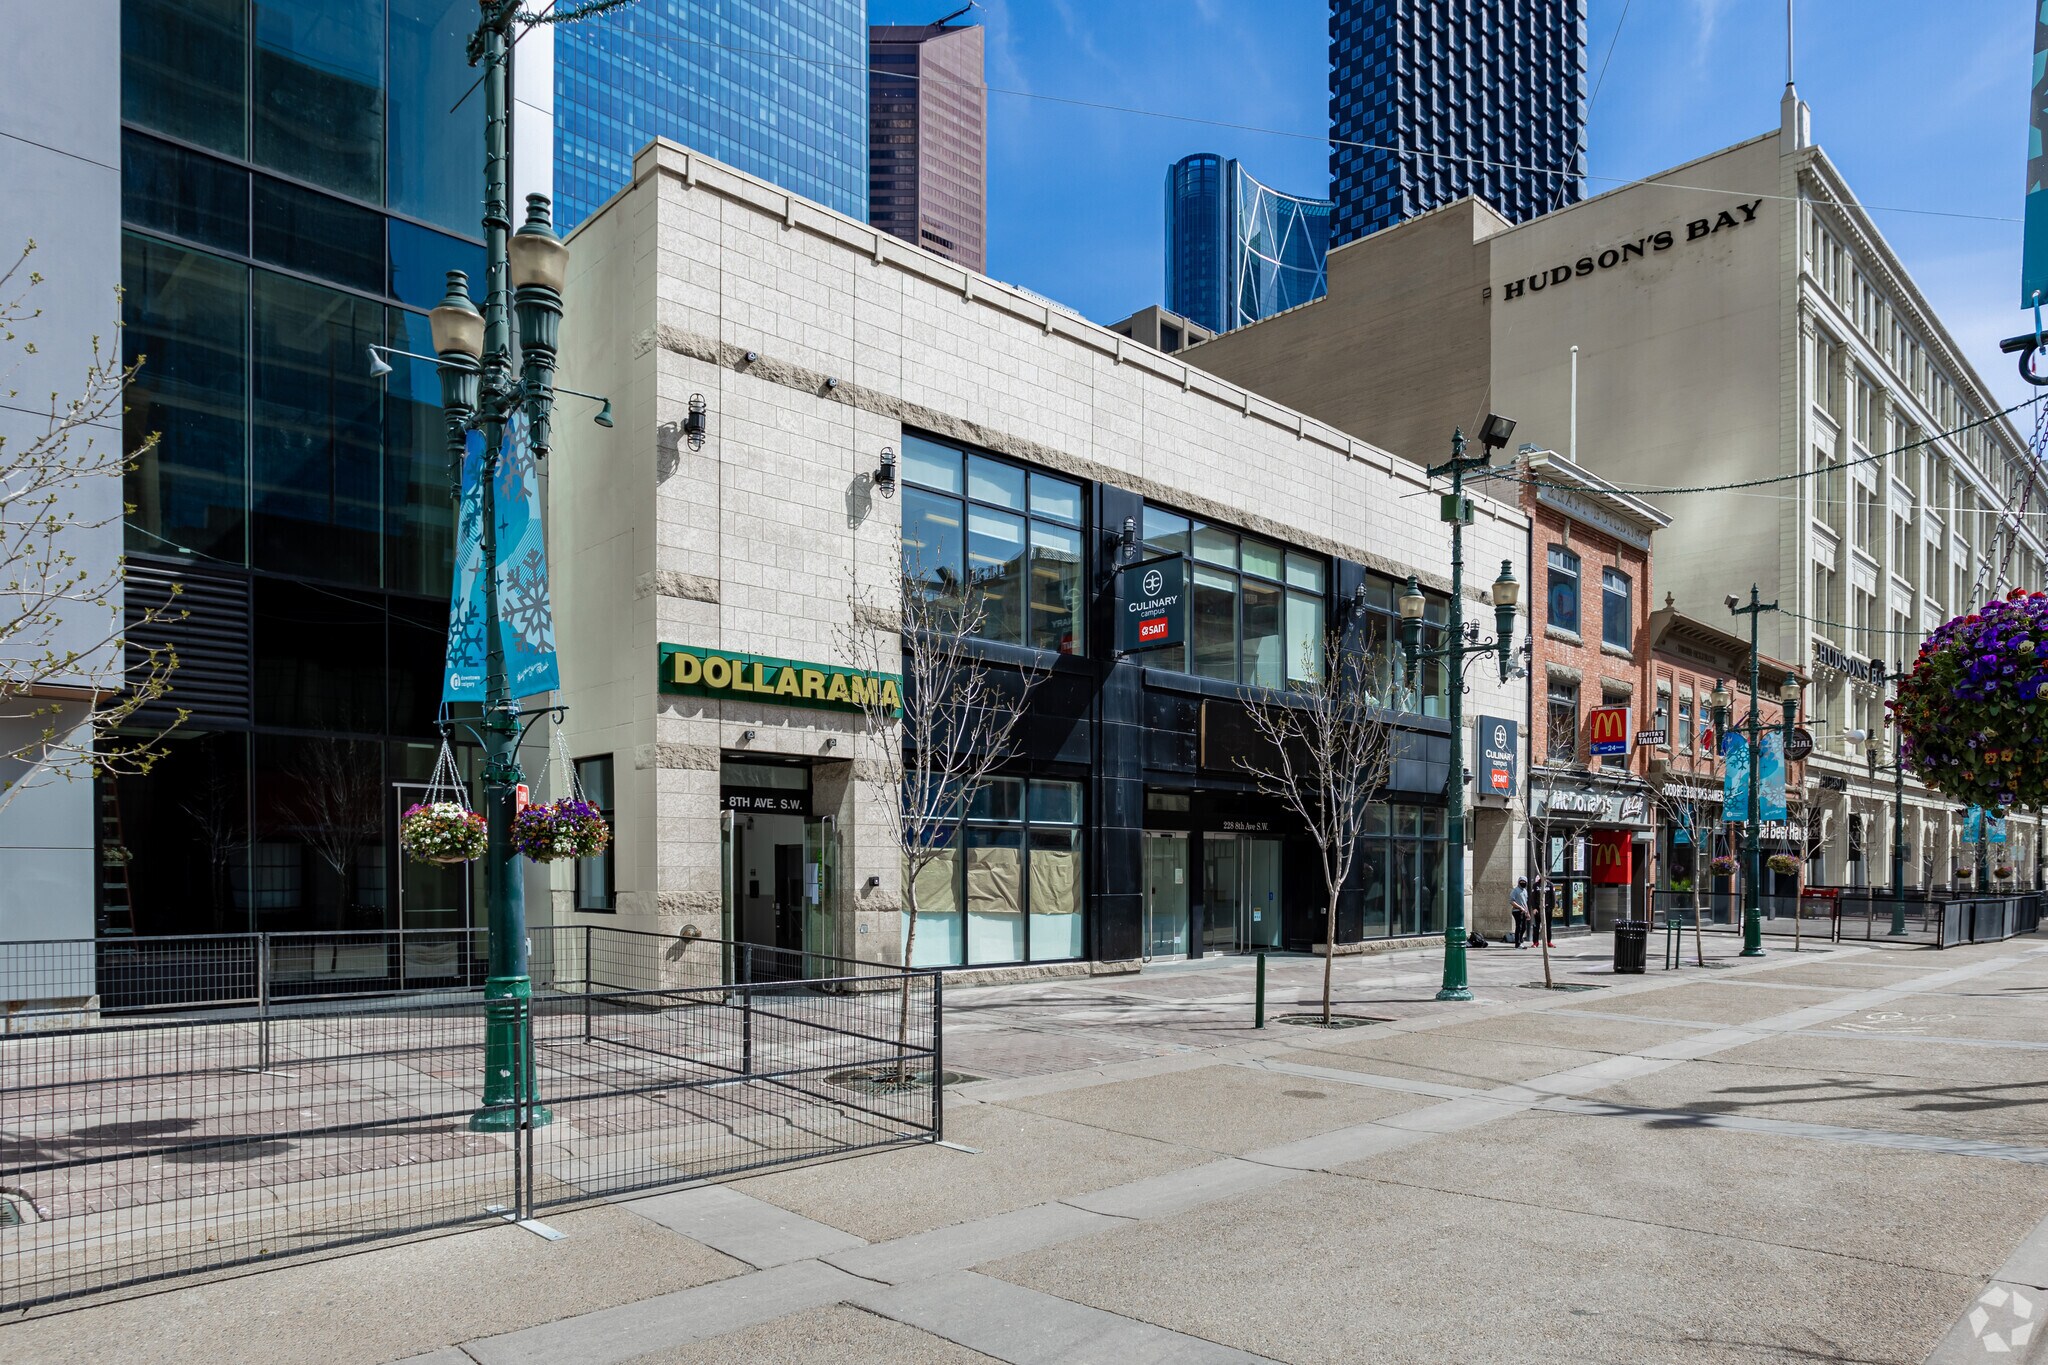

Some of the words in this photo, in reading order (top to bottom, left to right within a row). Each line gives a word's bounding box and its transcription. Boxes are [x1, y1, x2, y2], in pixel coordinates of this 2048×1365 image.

[1504, 231, 1674, 301] HUDSON'S
[1686, 199, 1762, 242] BAY
[1128, 595, 1178, 612] CULINARY
[1140, 607, 1166, 618] campus
[1148, 623, 1166, 635] SAIT
[673, 651, 902, 709] DOLLARAMA
[1638, 730, 1664, 738] ESPITA'S
[1638, 736, 1664, 745] TAILOR
[1607, 744, 1616, 752] 24
[1485, 749, 1515, 761] CULINARY
[729, 796, 750, 808] 8TH
[754, 797, 777, 809] AVE.
[780, 799, 803, 810] S.W.
[1223, 820, 1234, 830] 228
[1235, 820, 1245, 830] 8th
[1245, 821, 1256, 831] Ave
[1256, 821, 1269, 831] S.W.
[1770, 819, 1788, 840] Beer
